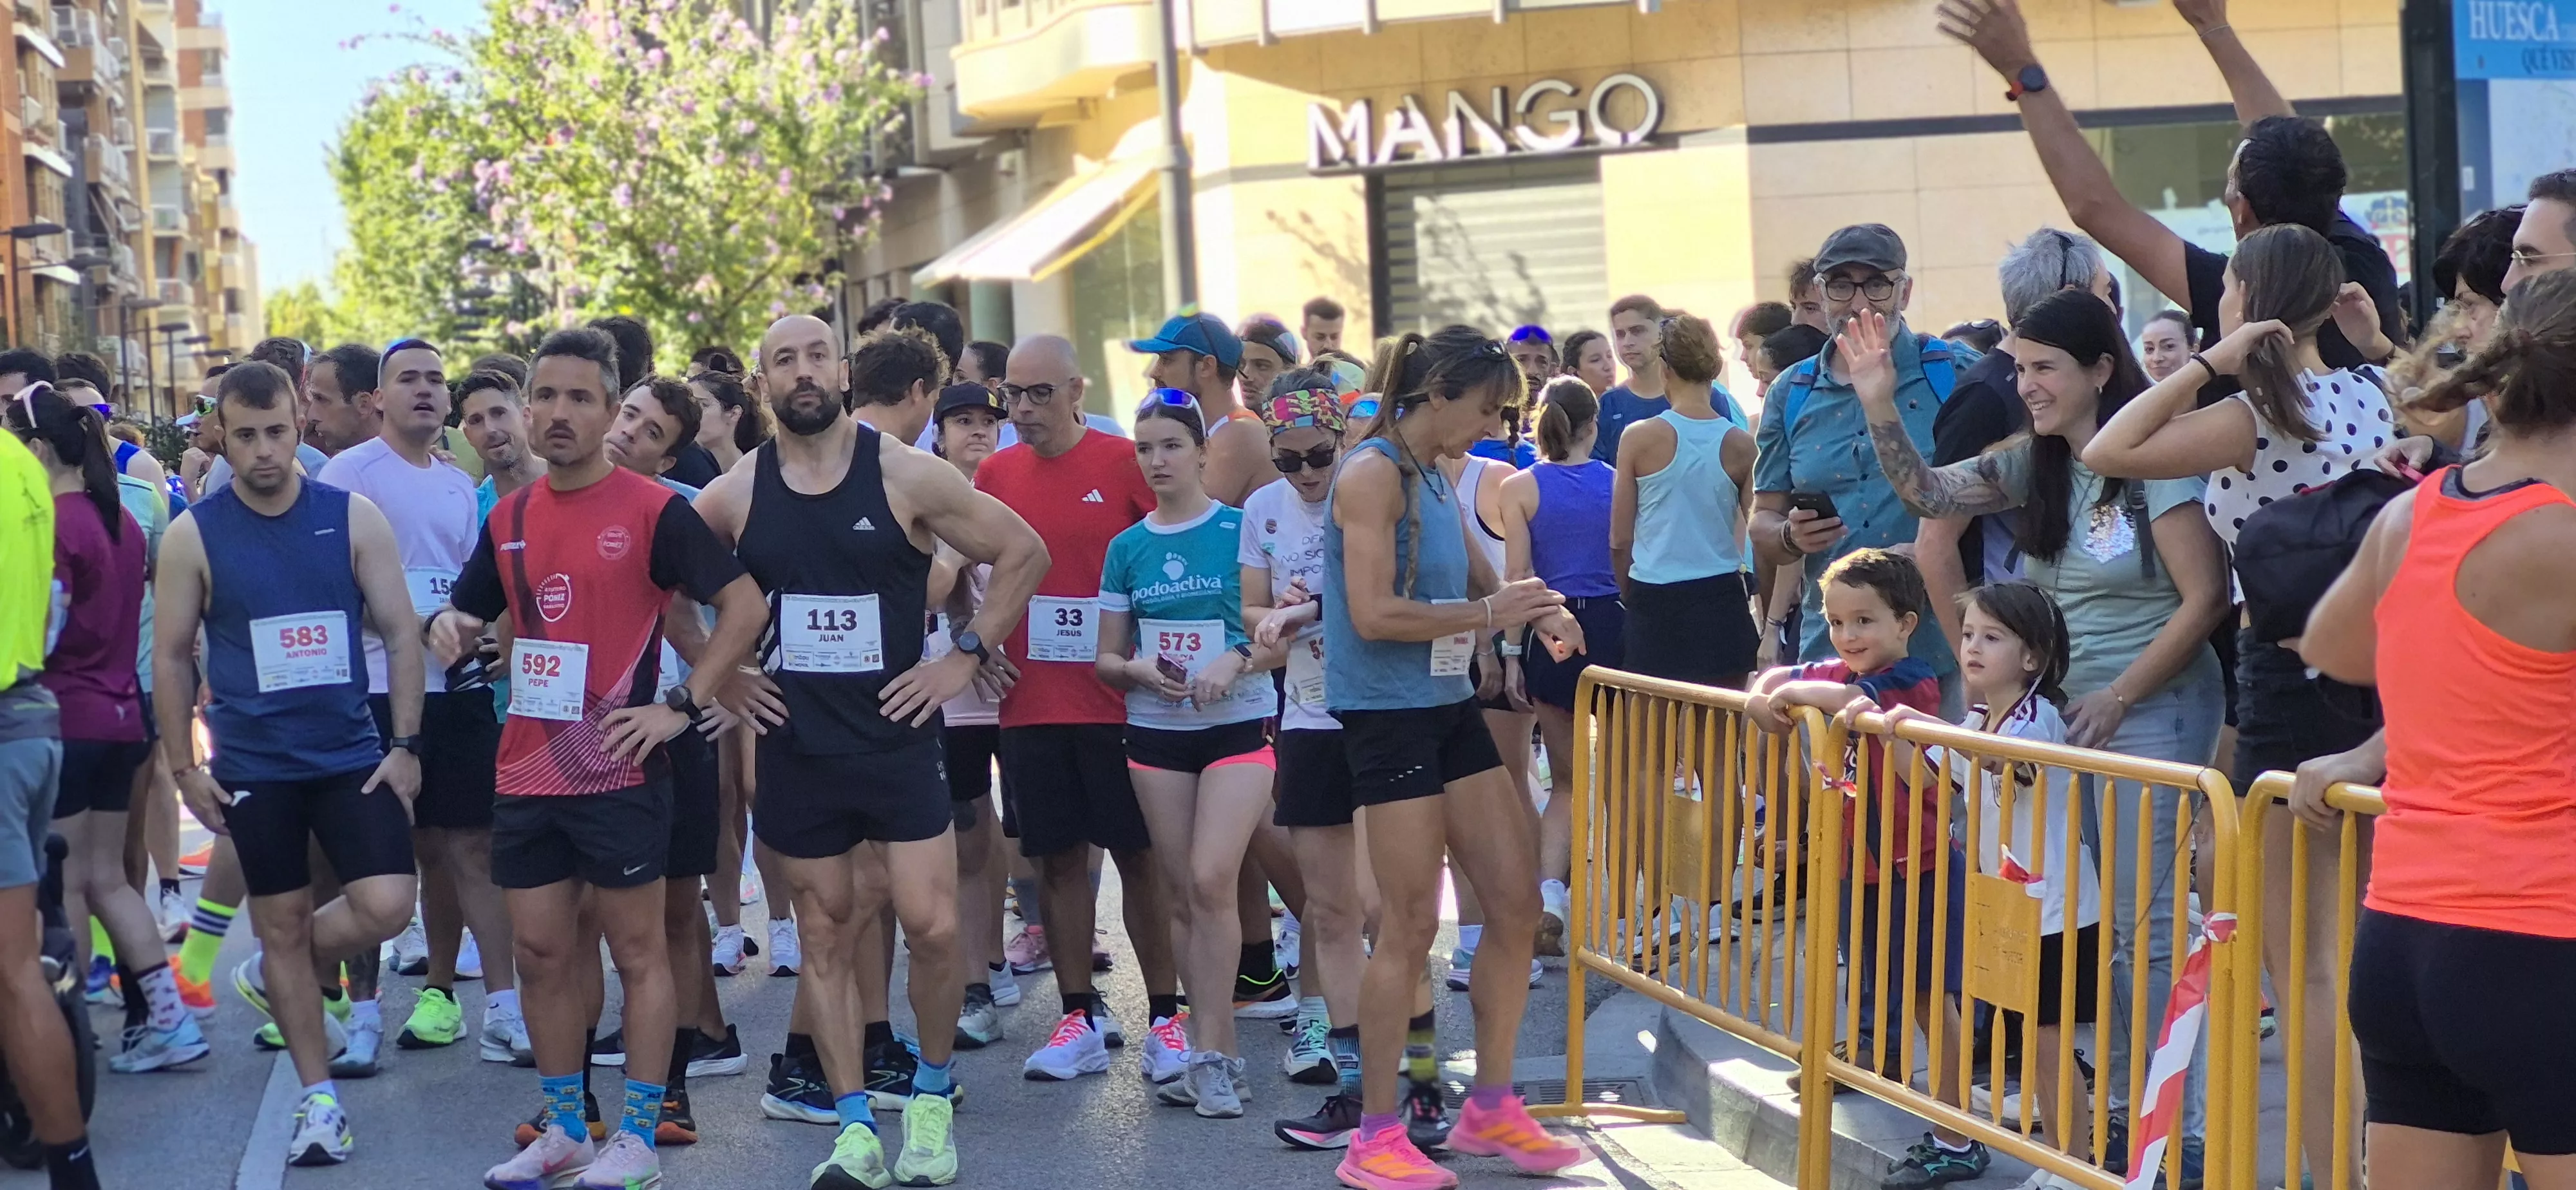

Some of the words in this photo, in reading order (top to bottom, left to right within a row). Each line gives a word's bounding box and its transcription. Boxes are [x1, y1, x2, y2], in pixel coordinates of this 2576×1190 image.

[2469, 1, 2560, 41] HUESCA
[1307, 73, 1664, 169] MANGO
[1281, 552, 1299, 565] NO
[1290, 564, 1323, 577] IMPO
[1132, 574, 1222, 609] podoactiva
[807, 609, 857, 631] 113
[1054, 608, 1083, 627] 33
[279, 625, 328, 648] 583
[1159, 632, 1202, 651] 573
[285, 648, 327, 659] ANTONIO
[522, 653, 561, 677] 592
[528, 678, 549, 688] PEPE
